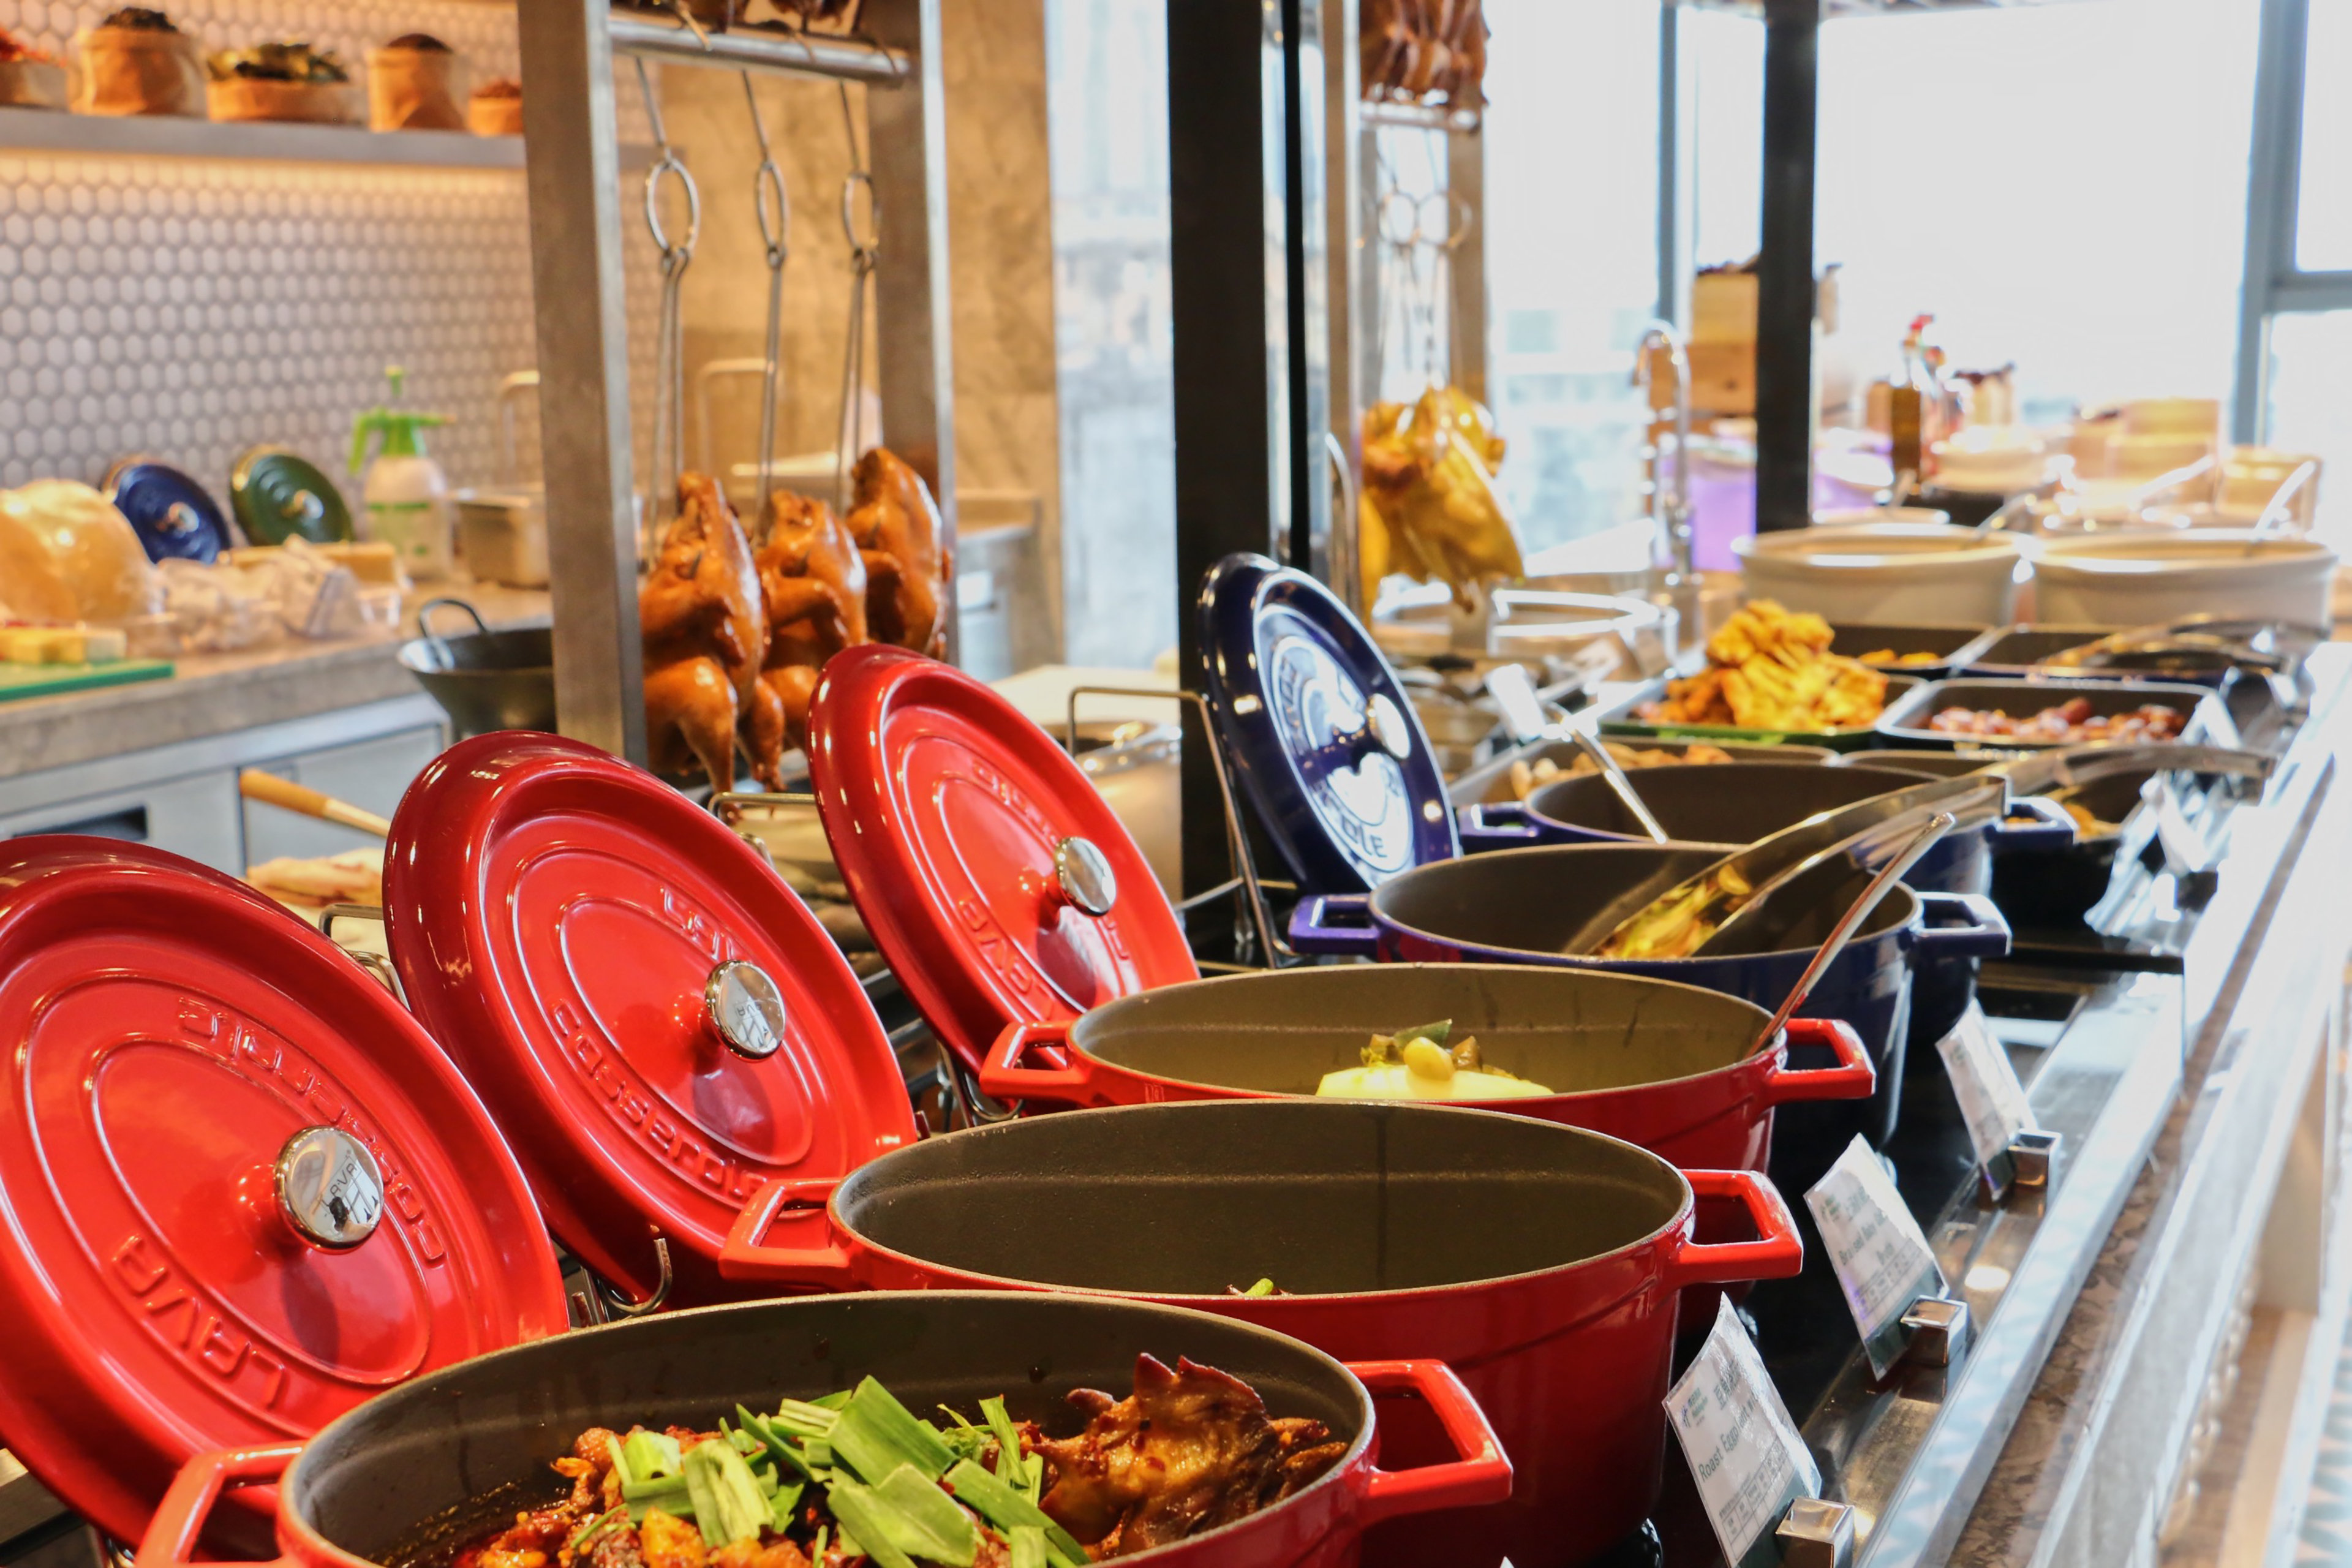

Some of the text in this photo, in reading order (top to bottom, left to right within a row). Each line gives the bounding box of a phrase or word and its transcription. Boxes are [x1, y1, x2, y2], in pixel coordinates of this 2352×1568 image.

[111, 1234, 290, 1411] LAVA
[1698, 1446, 1724, 1483] Roast
[1720, 1404, 1751, 1454] Eggplant
